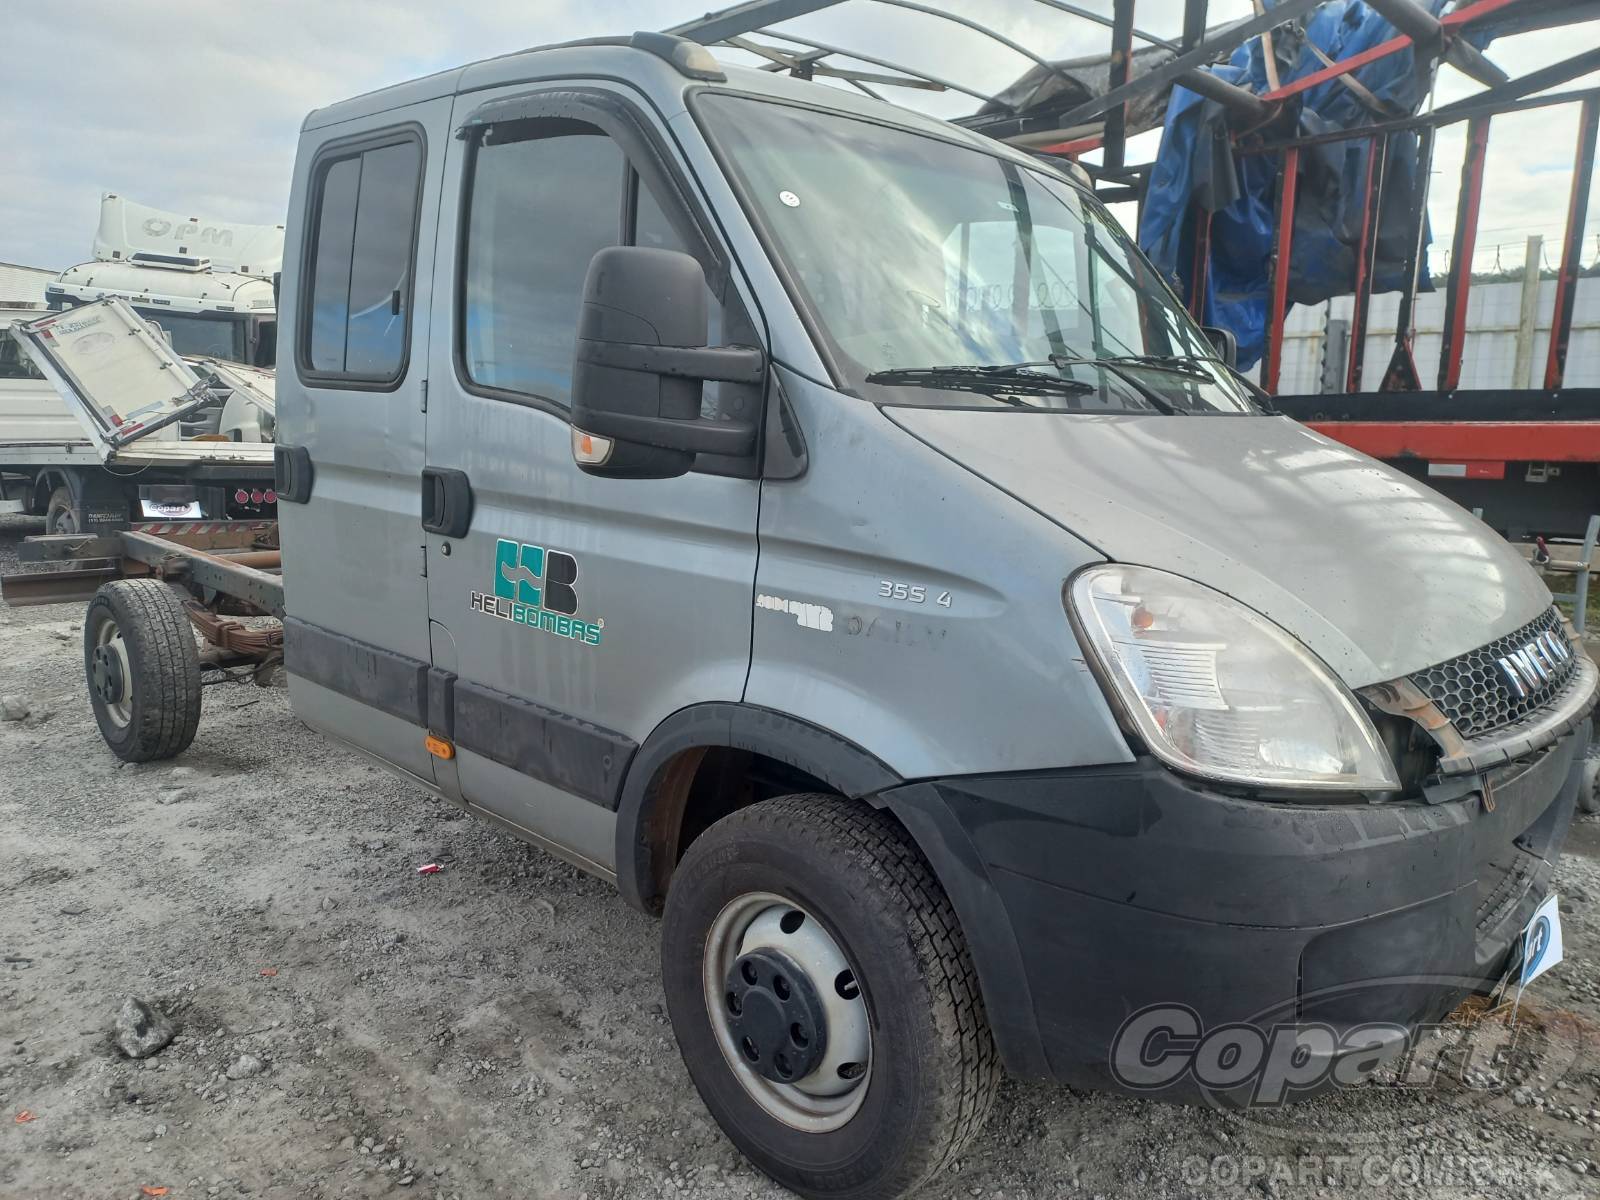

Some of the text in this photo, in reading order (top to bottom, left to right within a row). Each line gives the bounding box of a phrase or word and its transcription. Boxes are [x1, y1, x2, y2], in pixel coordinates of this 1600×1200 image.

[150, 503, 187, 513] Copart
[878, 580, 927, 604] 35S
[470, 591, 601, 646] HELIBOMBAS
